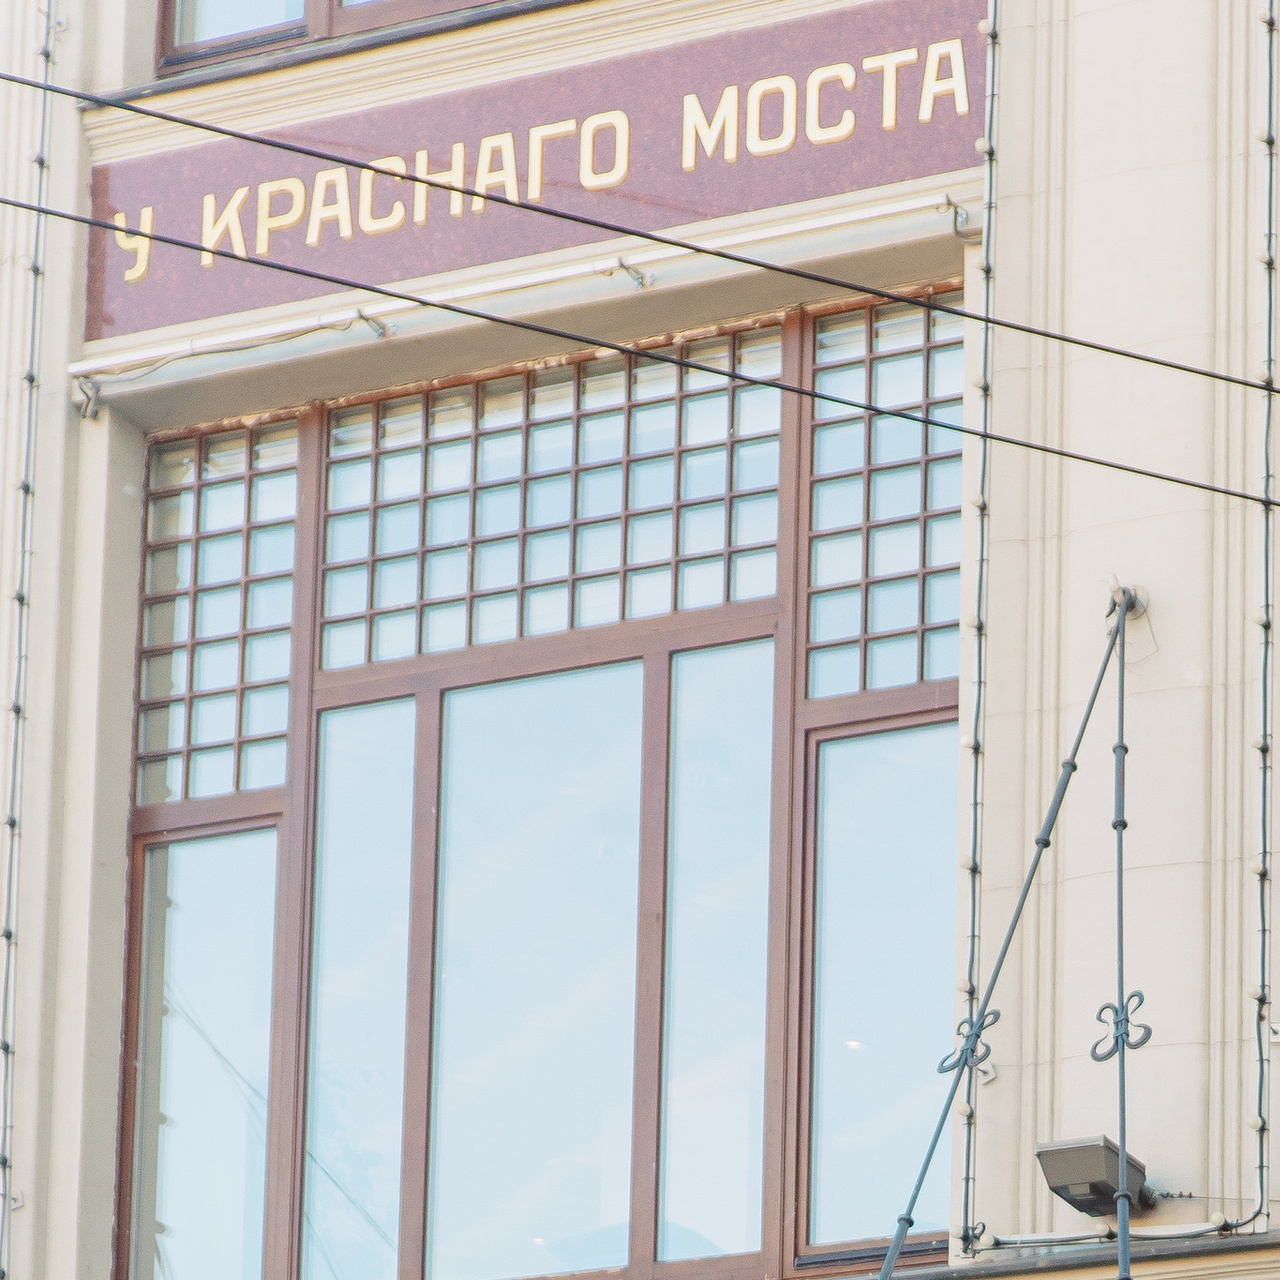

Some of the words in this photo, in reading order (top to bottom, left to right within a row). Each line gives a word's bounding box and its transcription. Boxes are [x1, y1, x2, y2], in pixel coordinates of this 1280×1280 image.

[113, 206, 154, 284] У
[200, 109, 631, 270] КРАСНАГО
[682, 38, 970, 173] МОСТА
